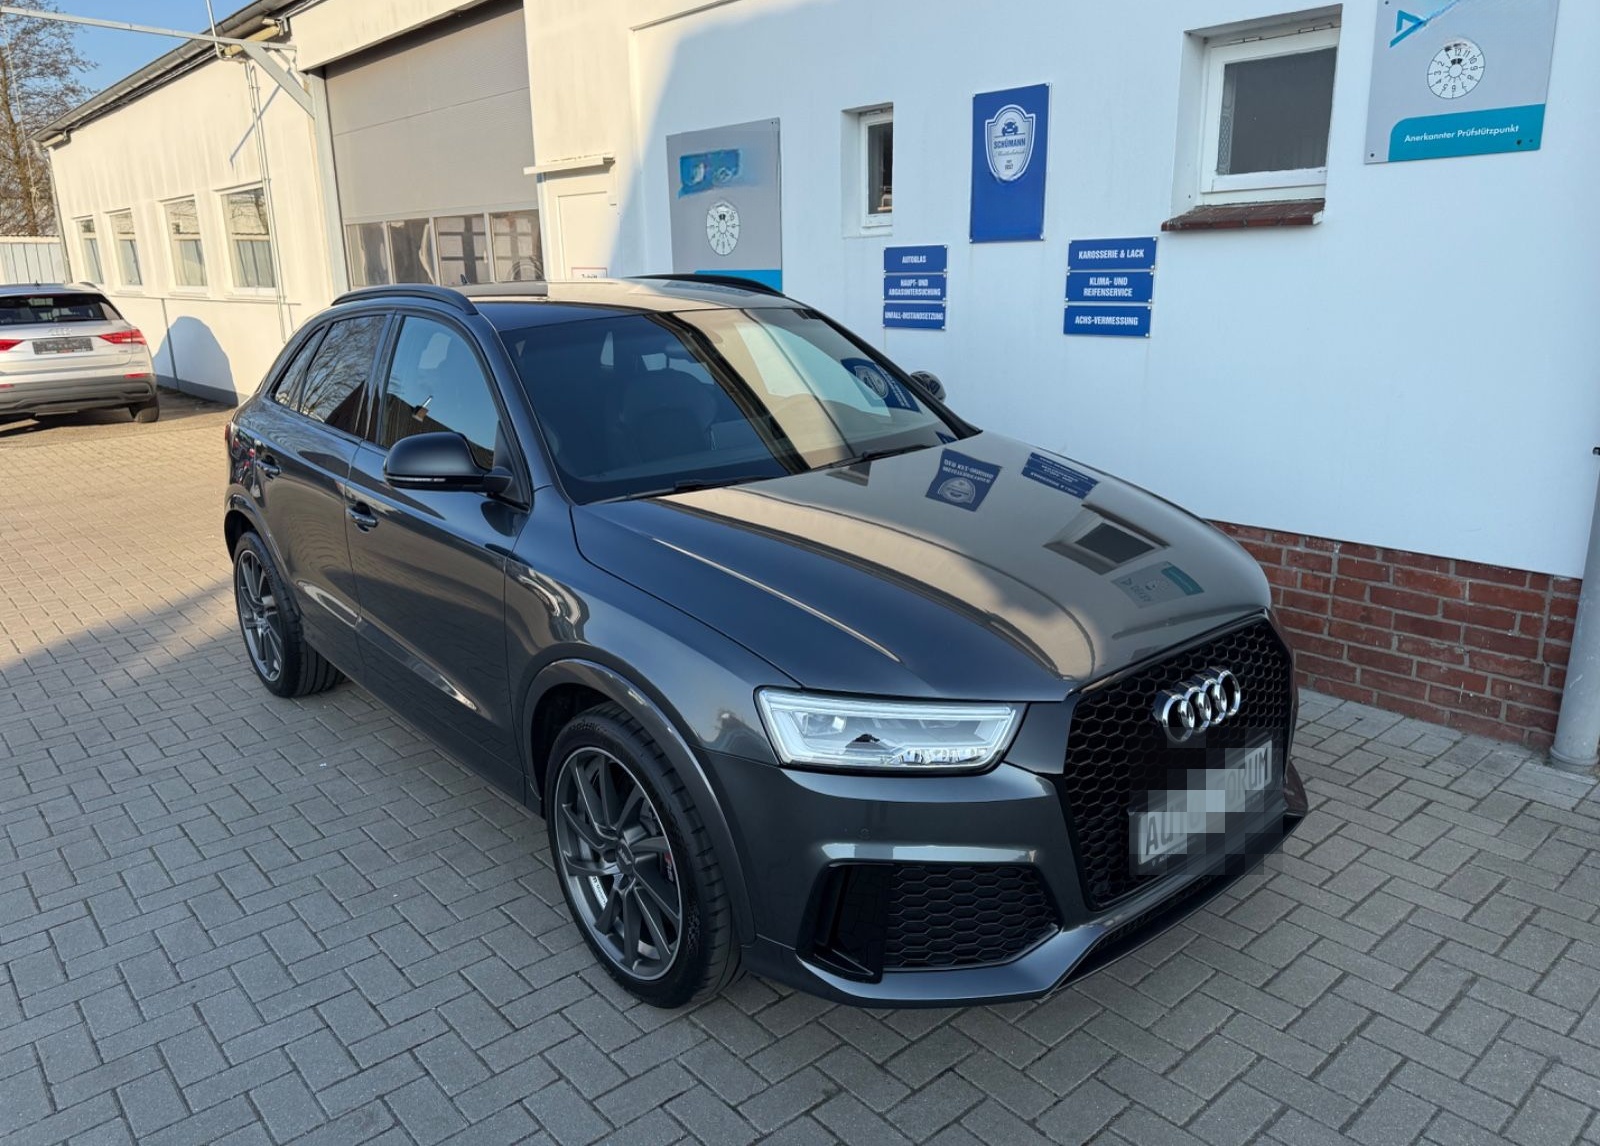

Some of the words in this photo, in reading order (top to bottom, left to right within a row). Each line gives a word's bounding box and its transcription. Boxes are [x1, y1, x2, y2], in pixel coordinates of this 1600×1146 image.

[1404, 131, 1455, 143] Anerkannter
[1457, 124, 1520, 138] Prüfstützpunkt
[902, 255, 927, 263] AUTOGLAS
[1078, 249, 1118, 260] KAROSSERIE
[1119, 249, 1126, 259] &
[1126, 248, 1145, 259] LACK
[917, 278, 929, 287] UND
[1089, 276, 1113, 286] KLIMA-
[1113, 277, 1128, 286] UND
[1083, 287, 1133, 297] REIFENSERVICE
[1074, 315, 1139, 326] ACHS-VERMESSUNG
